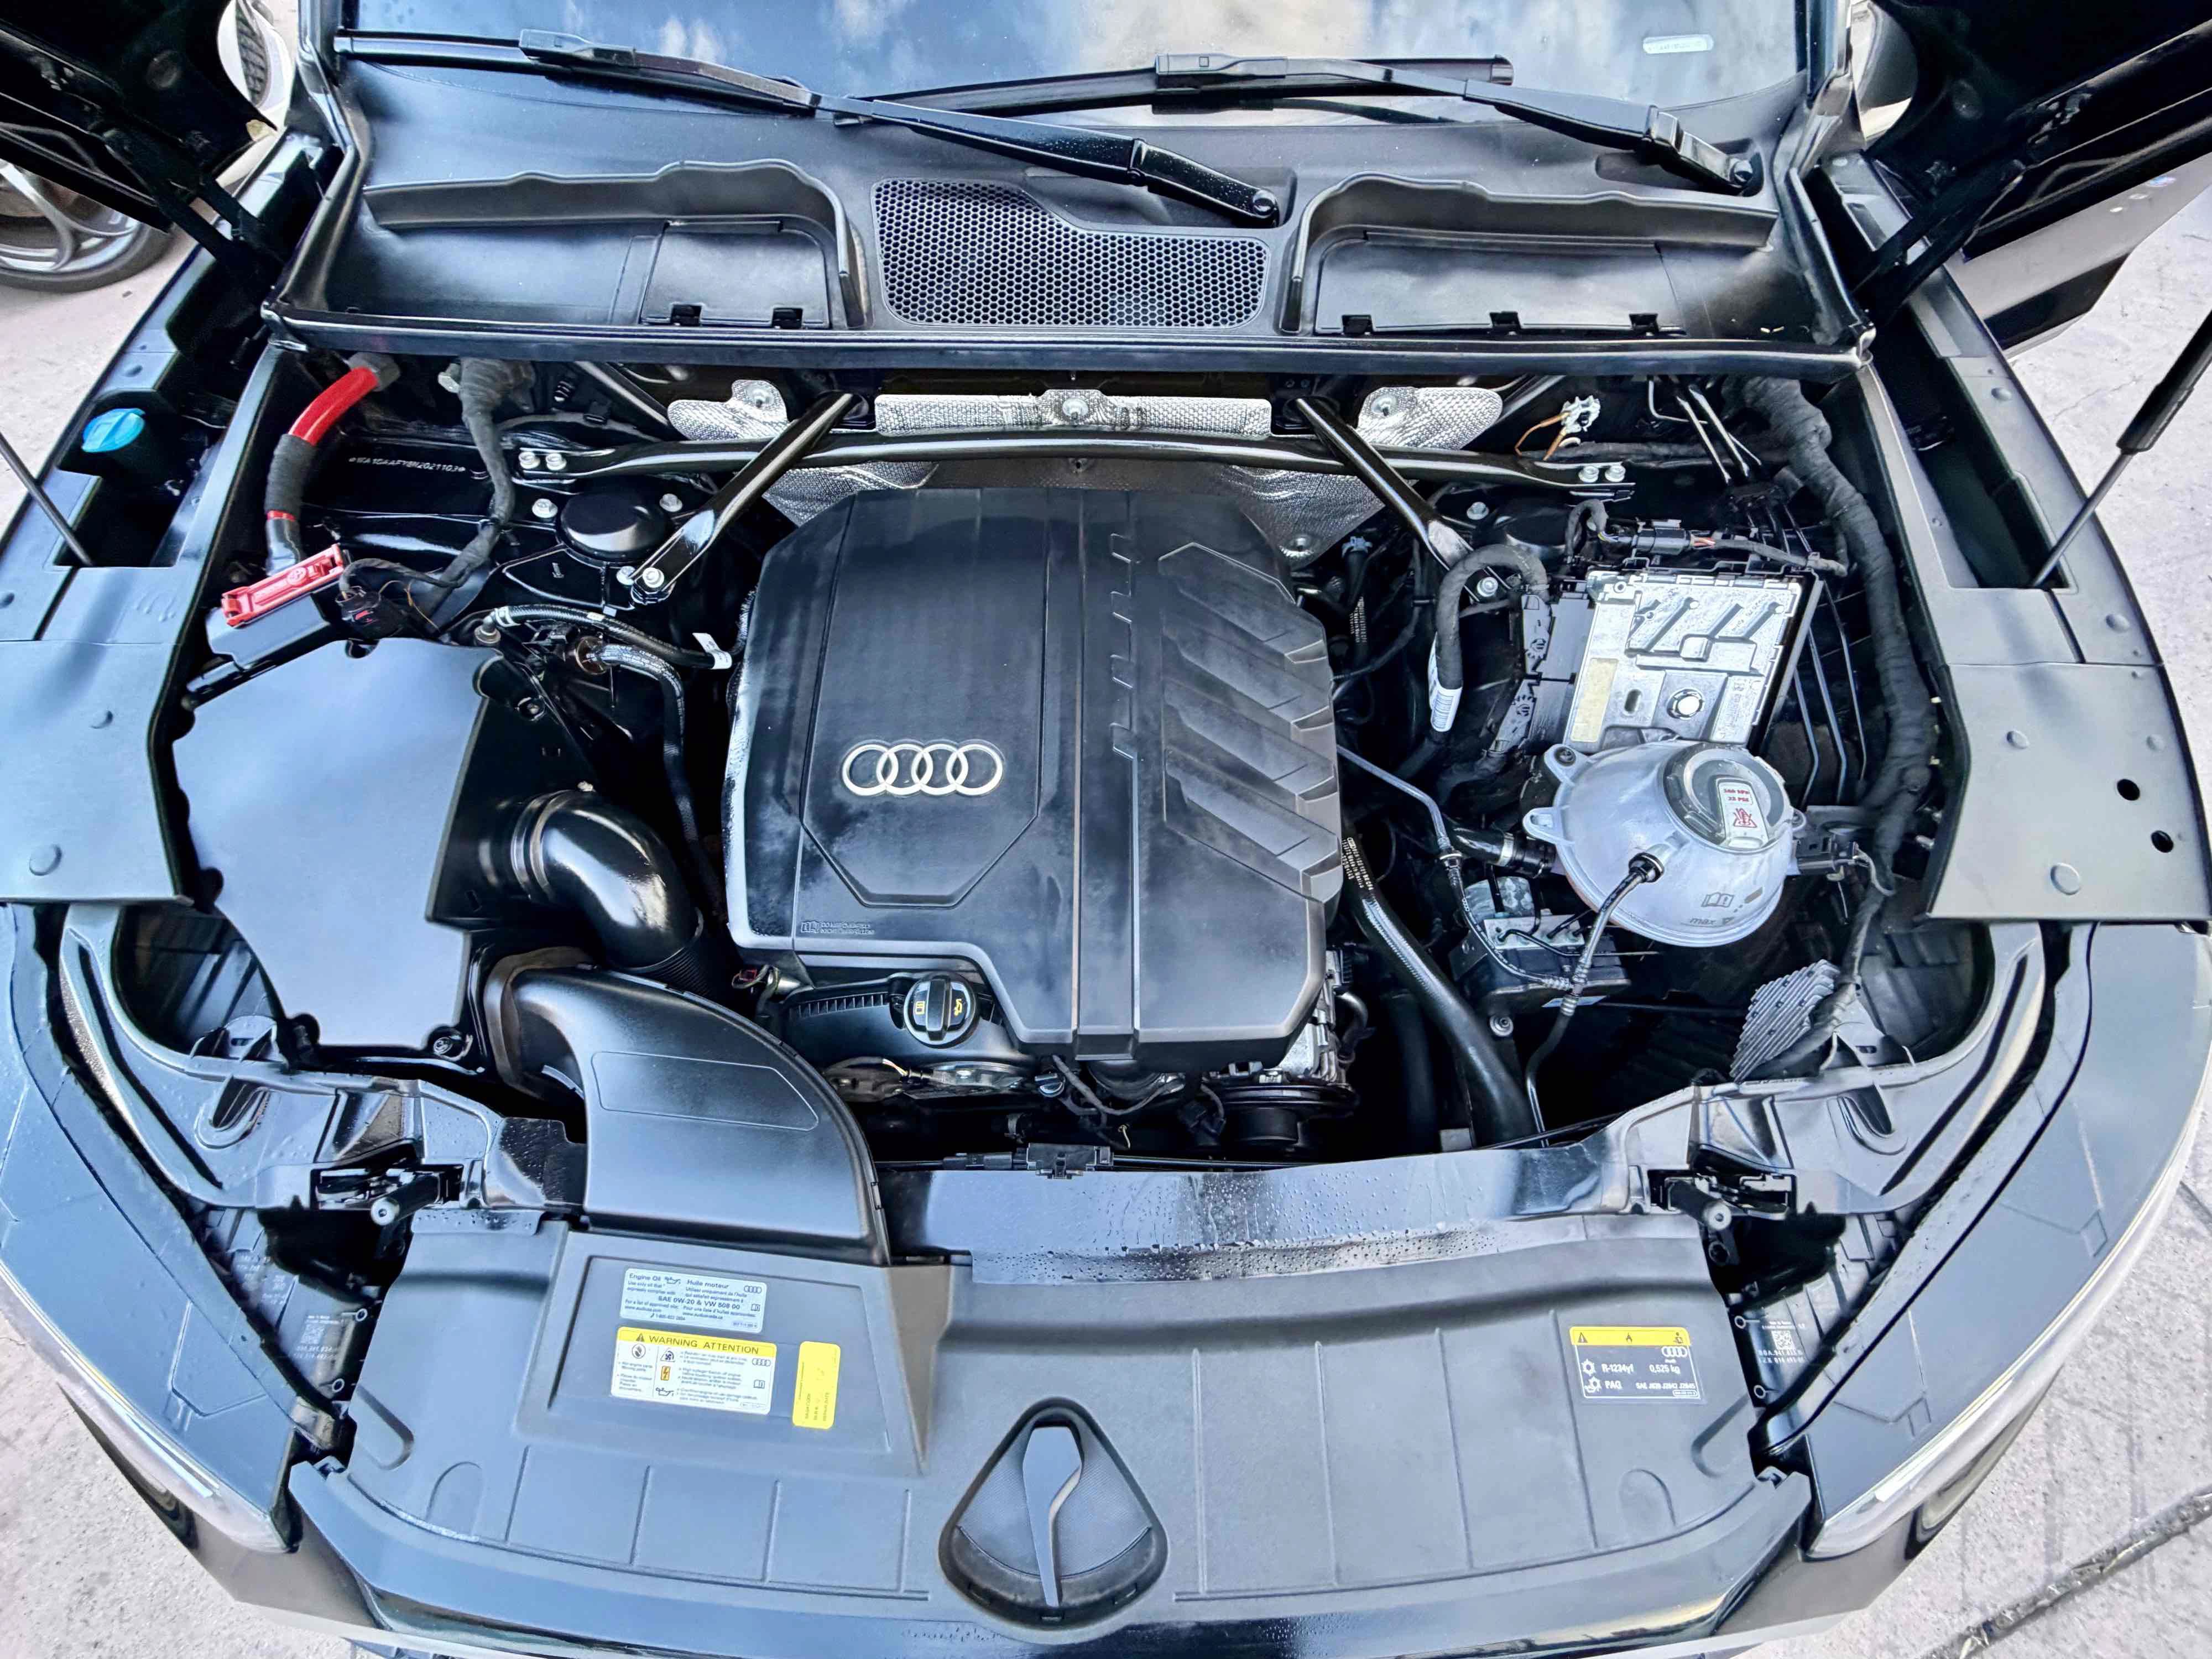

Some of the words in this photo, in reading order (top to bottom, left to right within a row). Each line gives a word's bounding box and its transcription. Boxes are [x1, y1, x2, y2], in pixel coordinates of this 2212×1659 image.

[649, 1335, 698, 1348] WARNING
[703, 1342, 759, 1354] ATTENTION
[1670, 1364, 1681, 1375] kg
[1605, 1380, 1623, 1390] PAG
